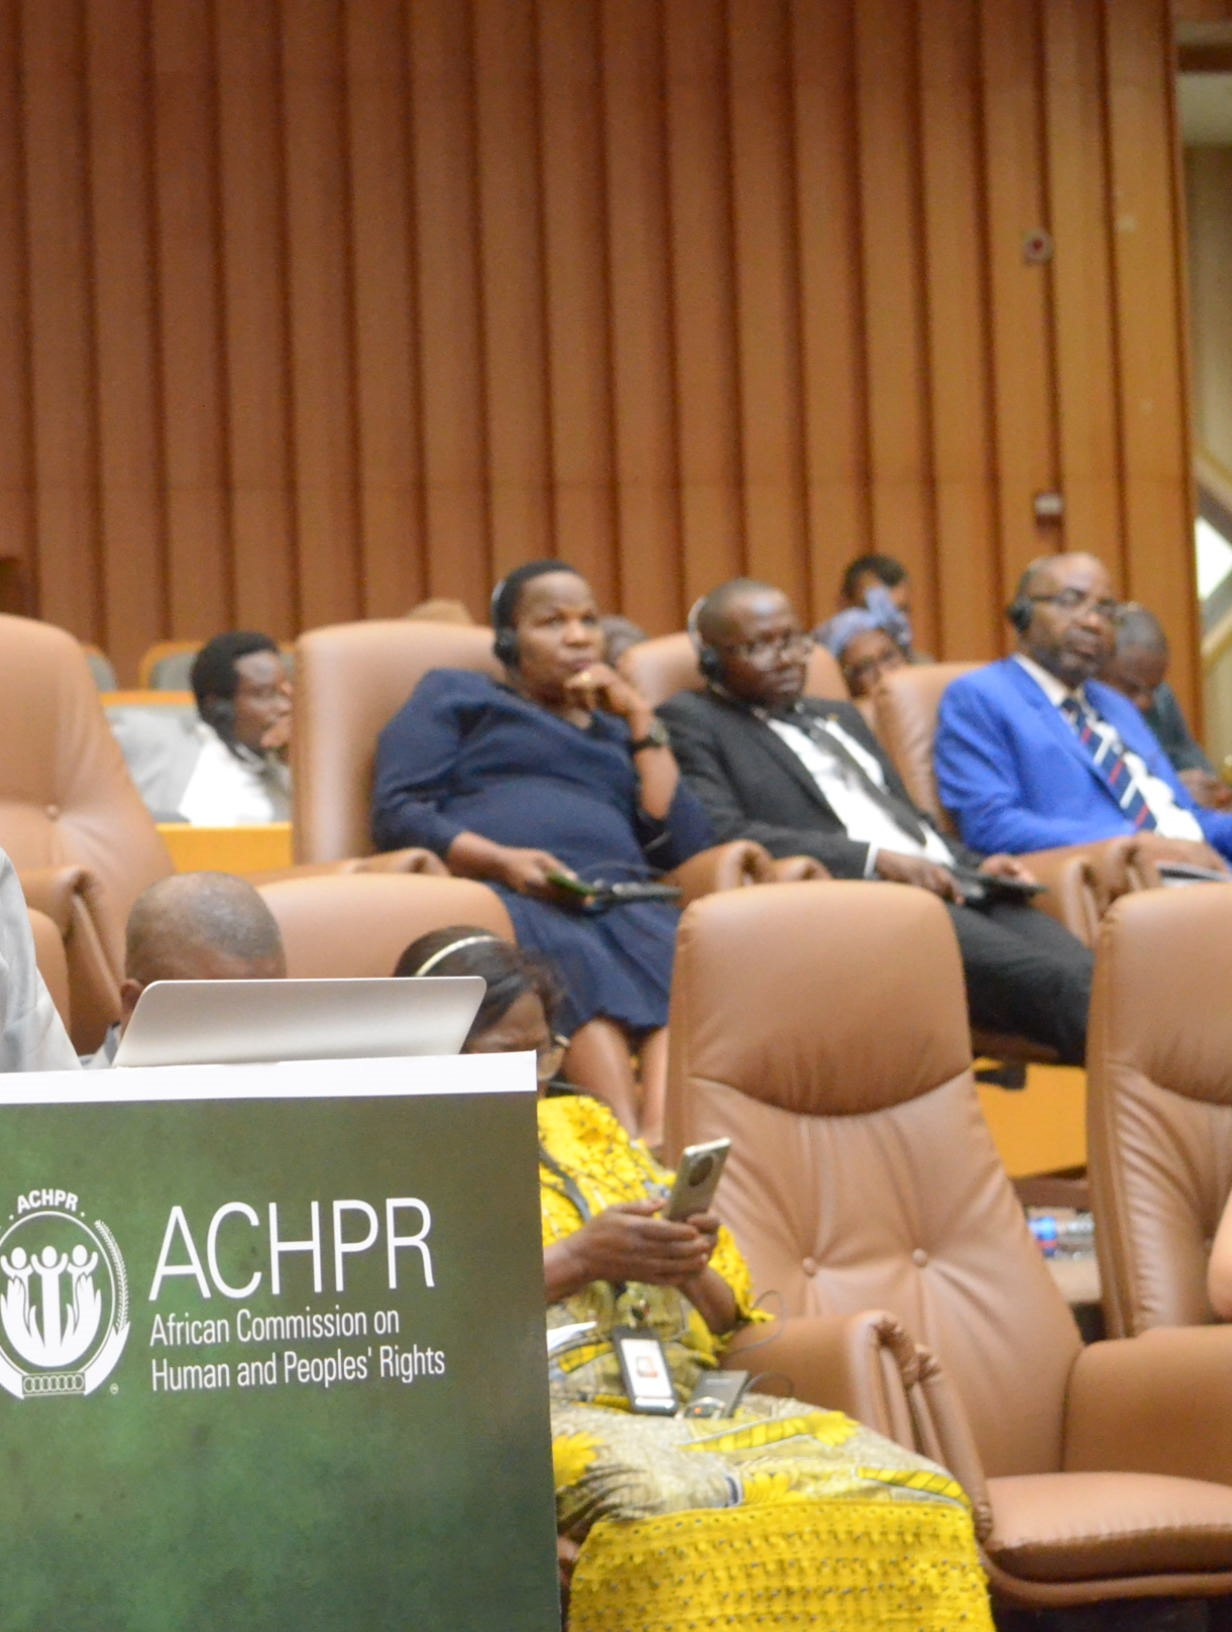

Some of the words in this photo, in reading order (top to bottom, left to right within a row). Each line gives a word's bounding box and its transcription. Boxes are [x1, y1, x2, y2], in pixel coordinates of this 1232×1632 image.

[16, 1188, 79, 1215] ACHPR
[148, 1196, 436, 1302] ACHPR
[149, 1311, 230, 1347] African
[236, 1304, 368, 1343] Commission
[373, 1309, 400, 1335] on
[151, 1358, 231, 1392] Human
[236, 1352, 278, 1388] and
[283, 1346, 372, 1389] Peoples'
[379, 1343, 446, 1384] Rights
